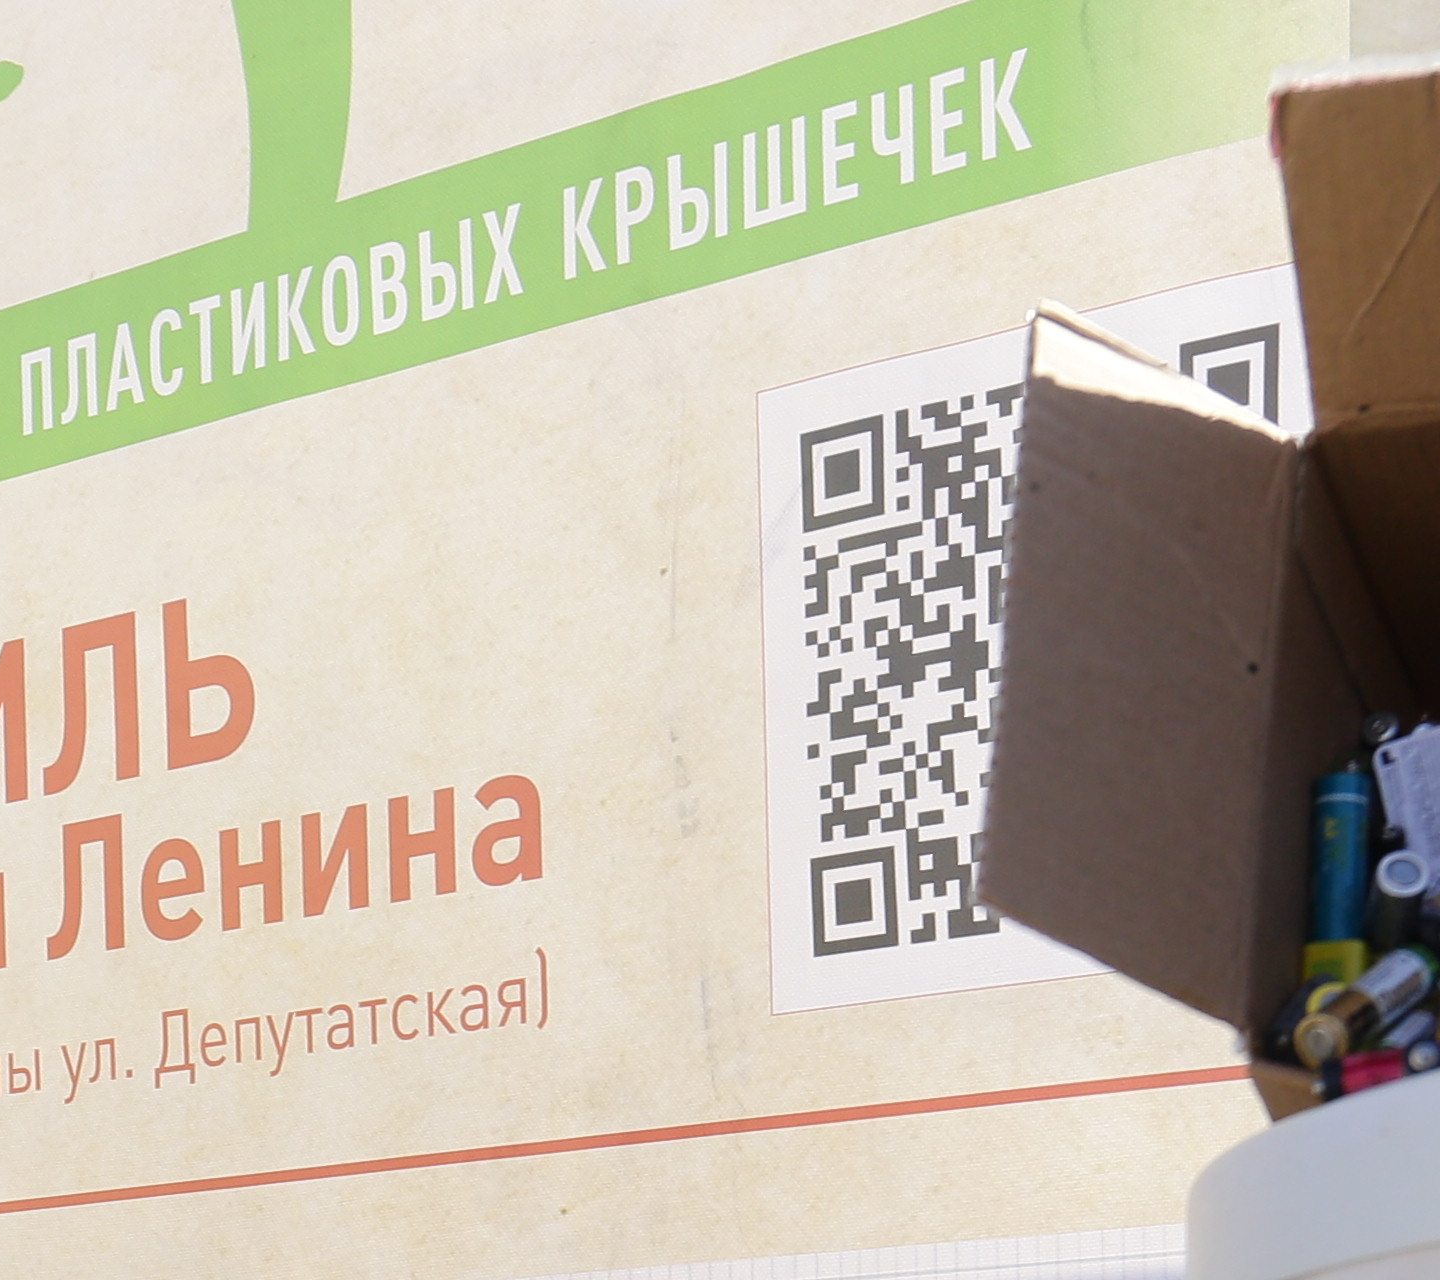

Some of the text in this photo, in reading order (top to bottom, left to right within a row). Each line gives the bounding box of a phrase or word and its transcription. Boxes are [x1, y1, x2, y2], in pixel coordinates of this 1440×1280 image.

[20, 202, 525, 436] ПЛАСТИКОВЫХ
[563, 47, 1032, 281] КРЫШЕЧЕК
[46, 773, 545, 961] Ленина
[62, 1027, 134, 1102] ул.
[155, 947, 550, 1083] Депутатская)
